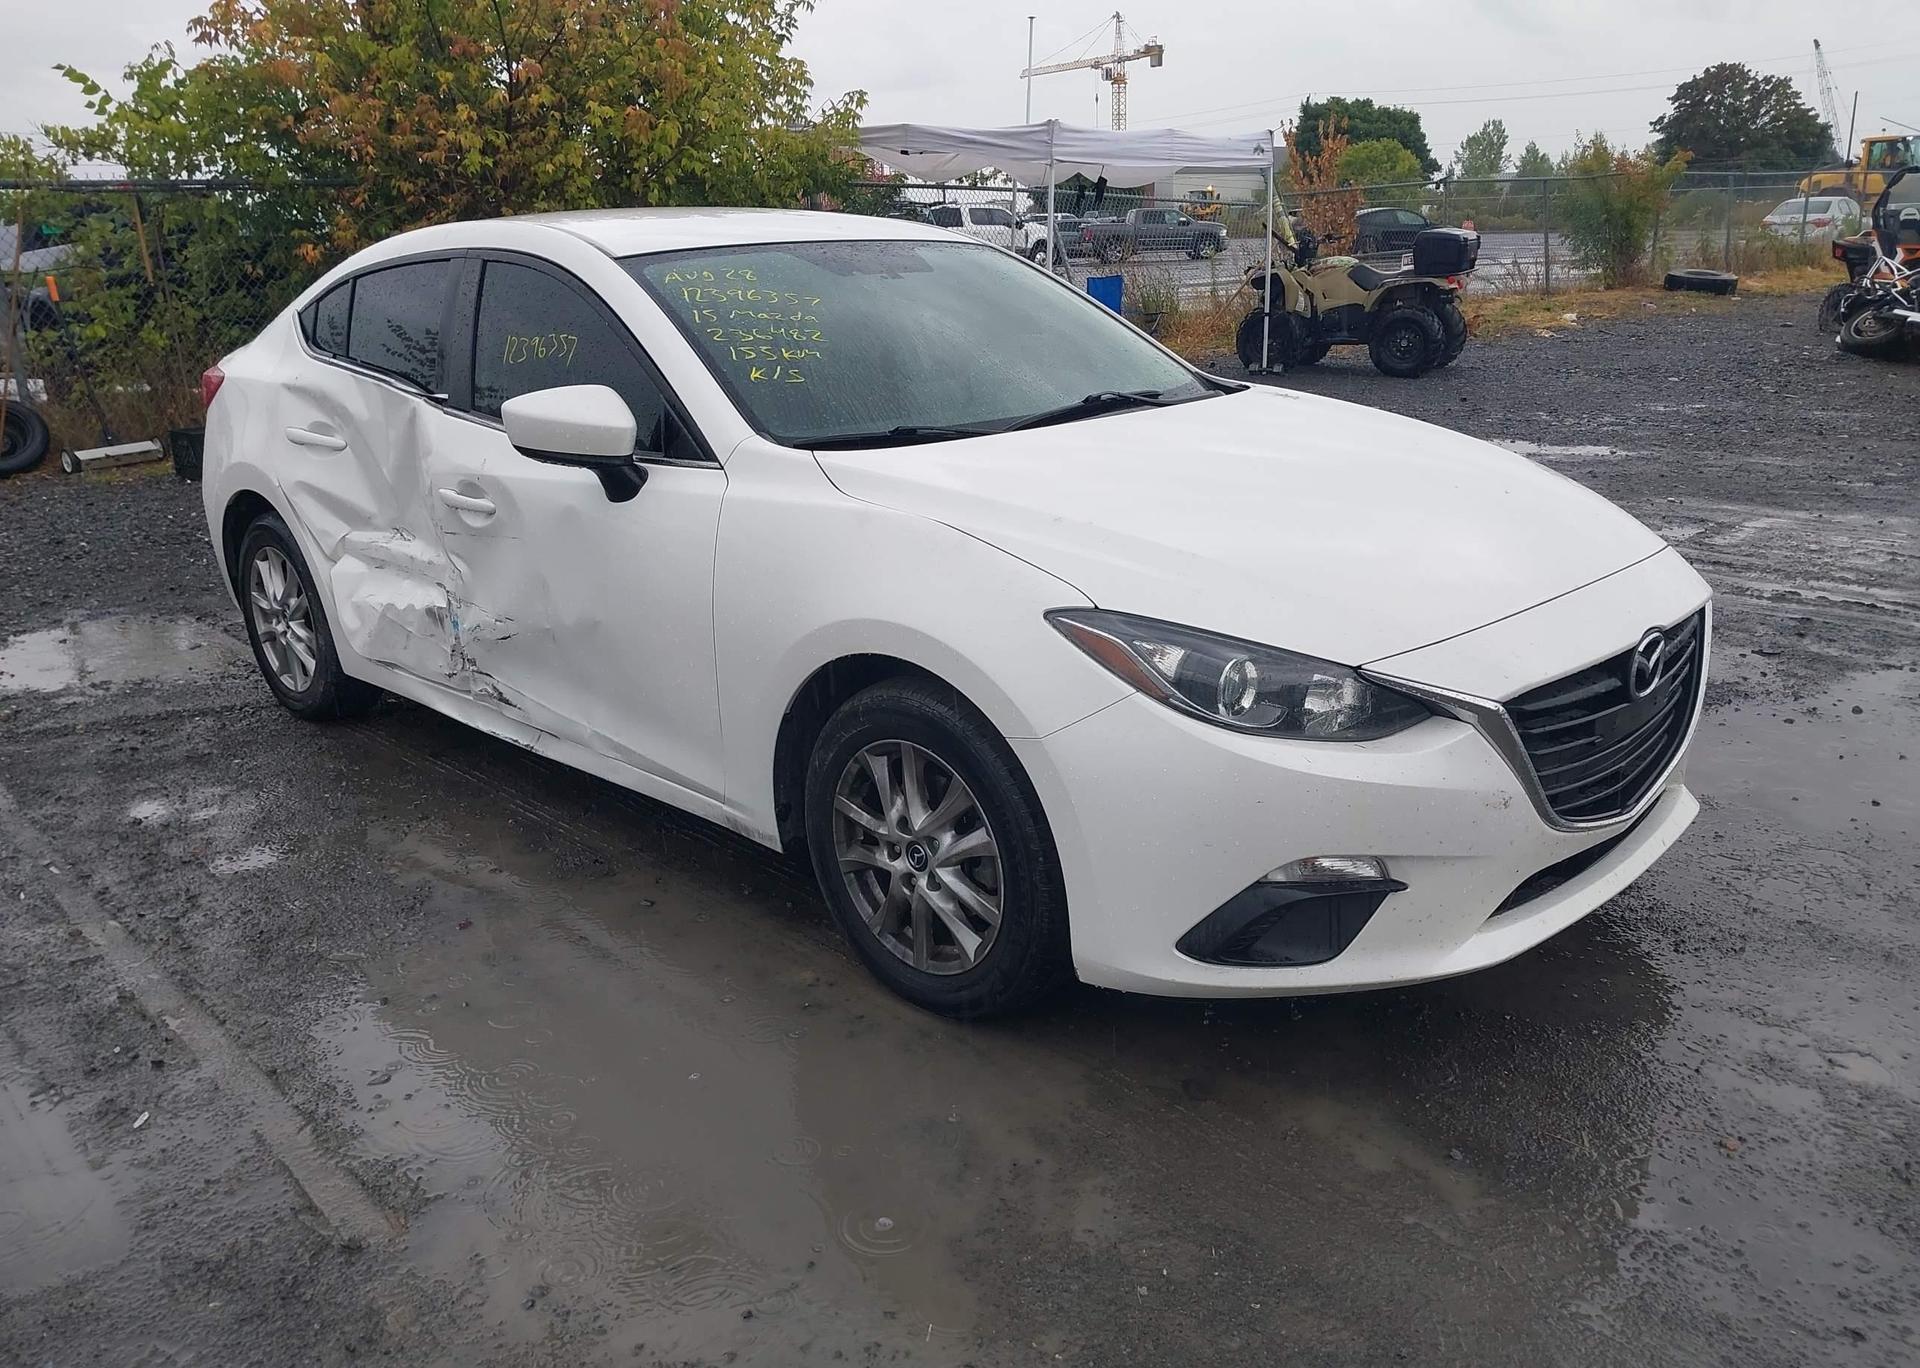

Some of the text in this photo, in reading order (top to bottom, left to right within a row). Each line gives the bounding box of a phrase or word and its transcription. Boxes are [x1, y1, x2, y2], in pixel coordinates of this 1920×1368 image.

[720, 267, 757, 281] 28
[682, 286, 821, 307] 12396357
[692, 309, 819, 324] 15 Mazda
[706, 323, 829, 342] 236482
[503, 333, 578, 367] 12396357
